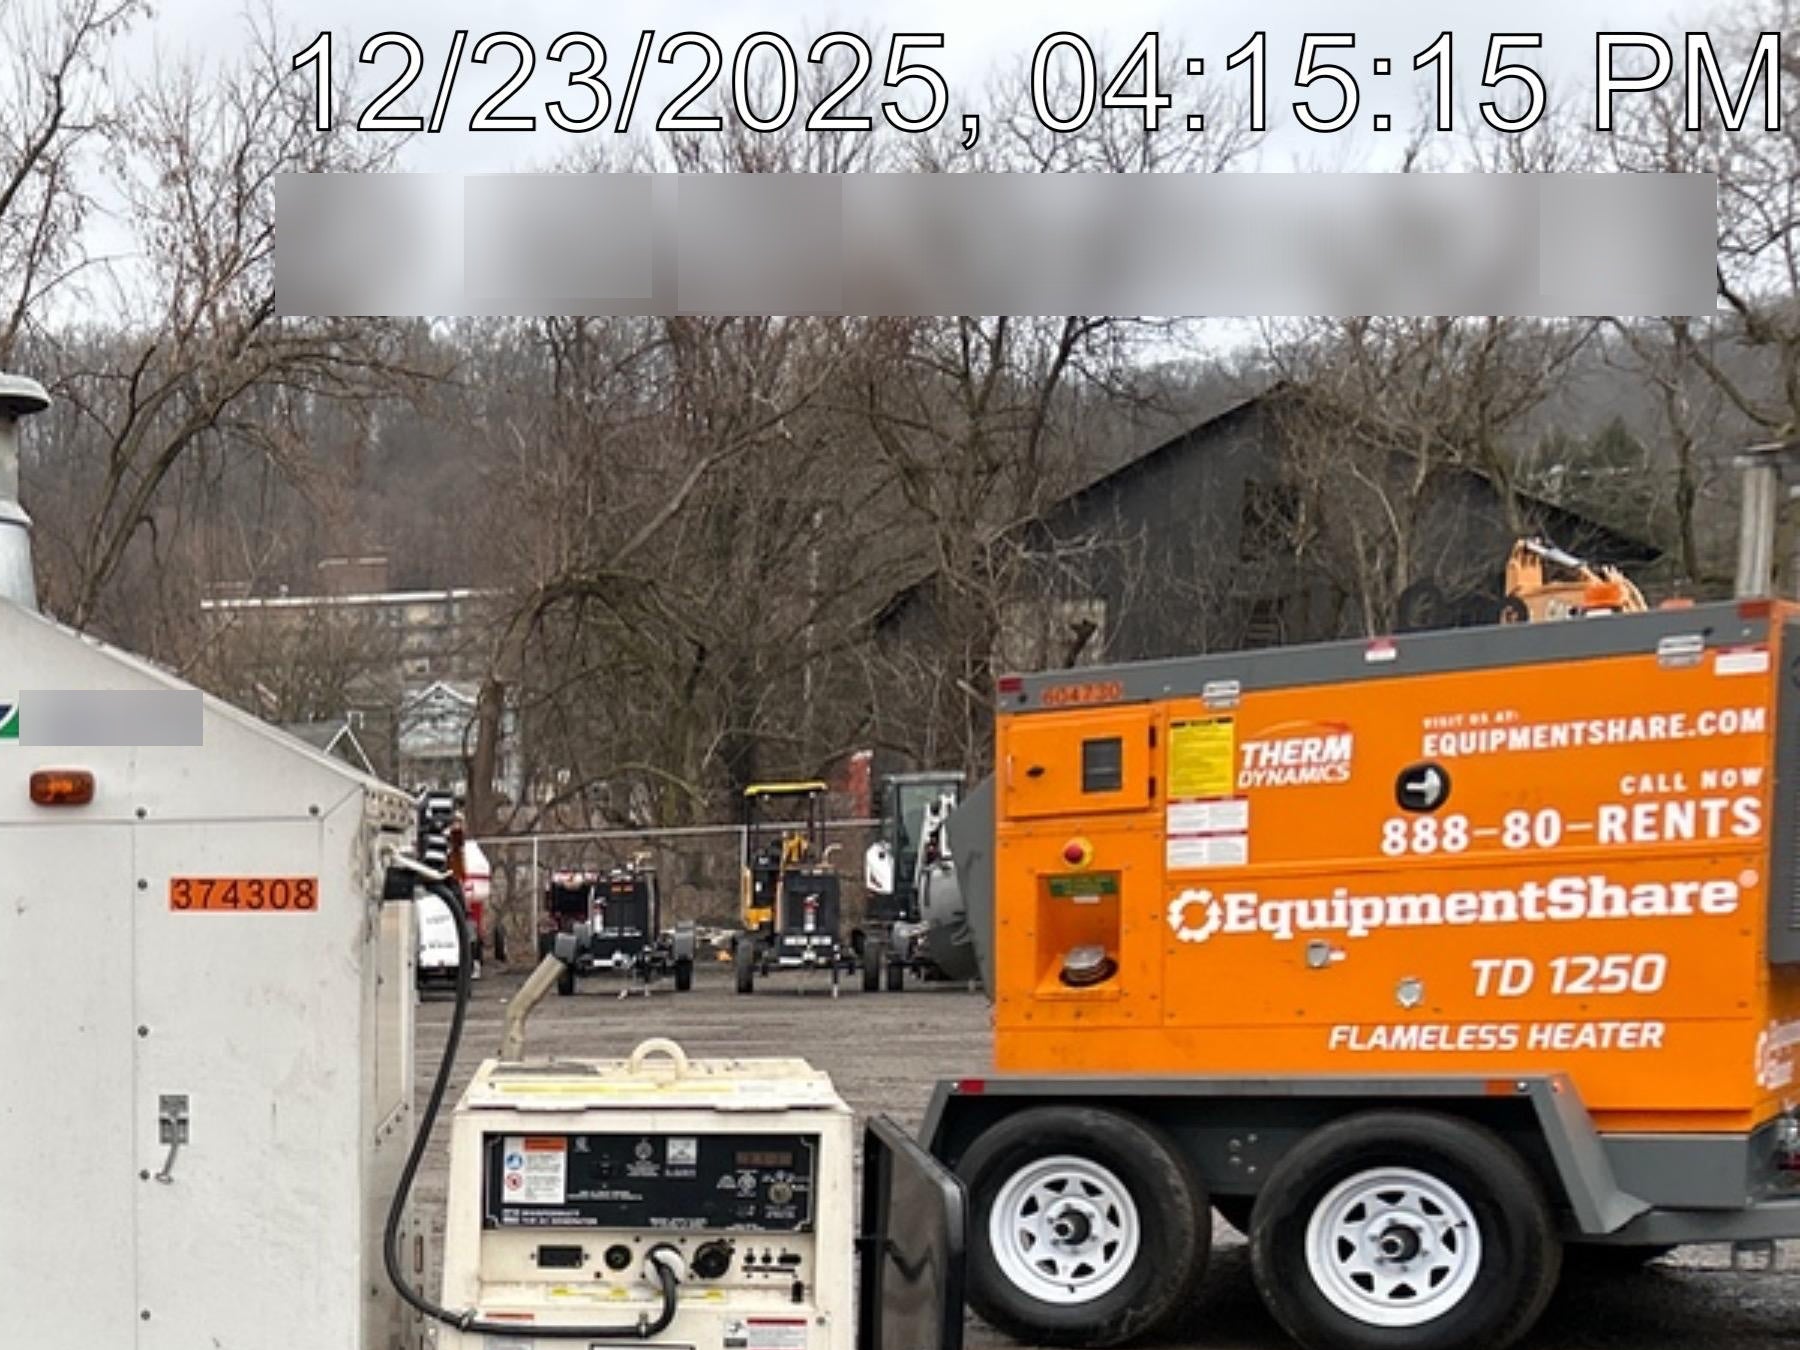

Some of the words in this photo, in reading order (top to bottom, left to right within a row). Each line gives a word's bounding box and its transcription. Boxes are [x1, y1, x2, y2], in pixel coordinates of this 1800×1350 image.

[1422, 706, 1767, 758] EQUIPMENTSHARE.COM
[1239, 733, 1354, 767] THERM
[1237, 763, 1351, 789] DYNAMICS
[1620, 773, 1688, 796] CALL
[1700, 766, 1764, 791] NOW
[1381, 796, 1763, 856] 888-80-RENTS
[172, 878, 316, 910] 374308
[1221, 876, 1739, 938] EquipmentShare
[1471, 959, 1535, 997] TD
[1547, 954, 1668, 994] 1250
[1328, 1024, 1520, 1052] FLAMELESS
[1526, 1022, 1664, 1050] HEATER
